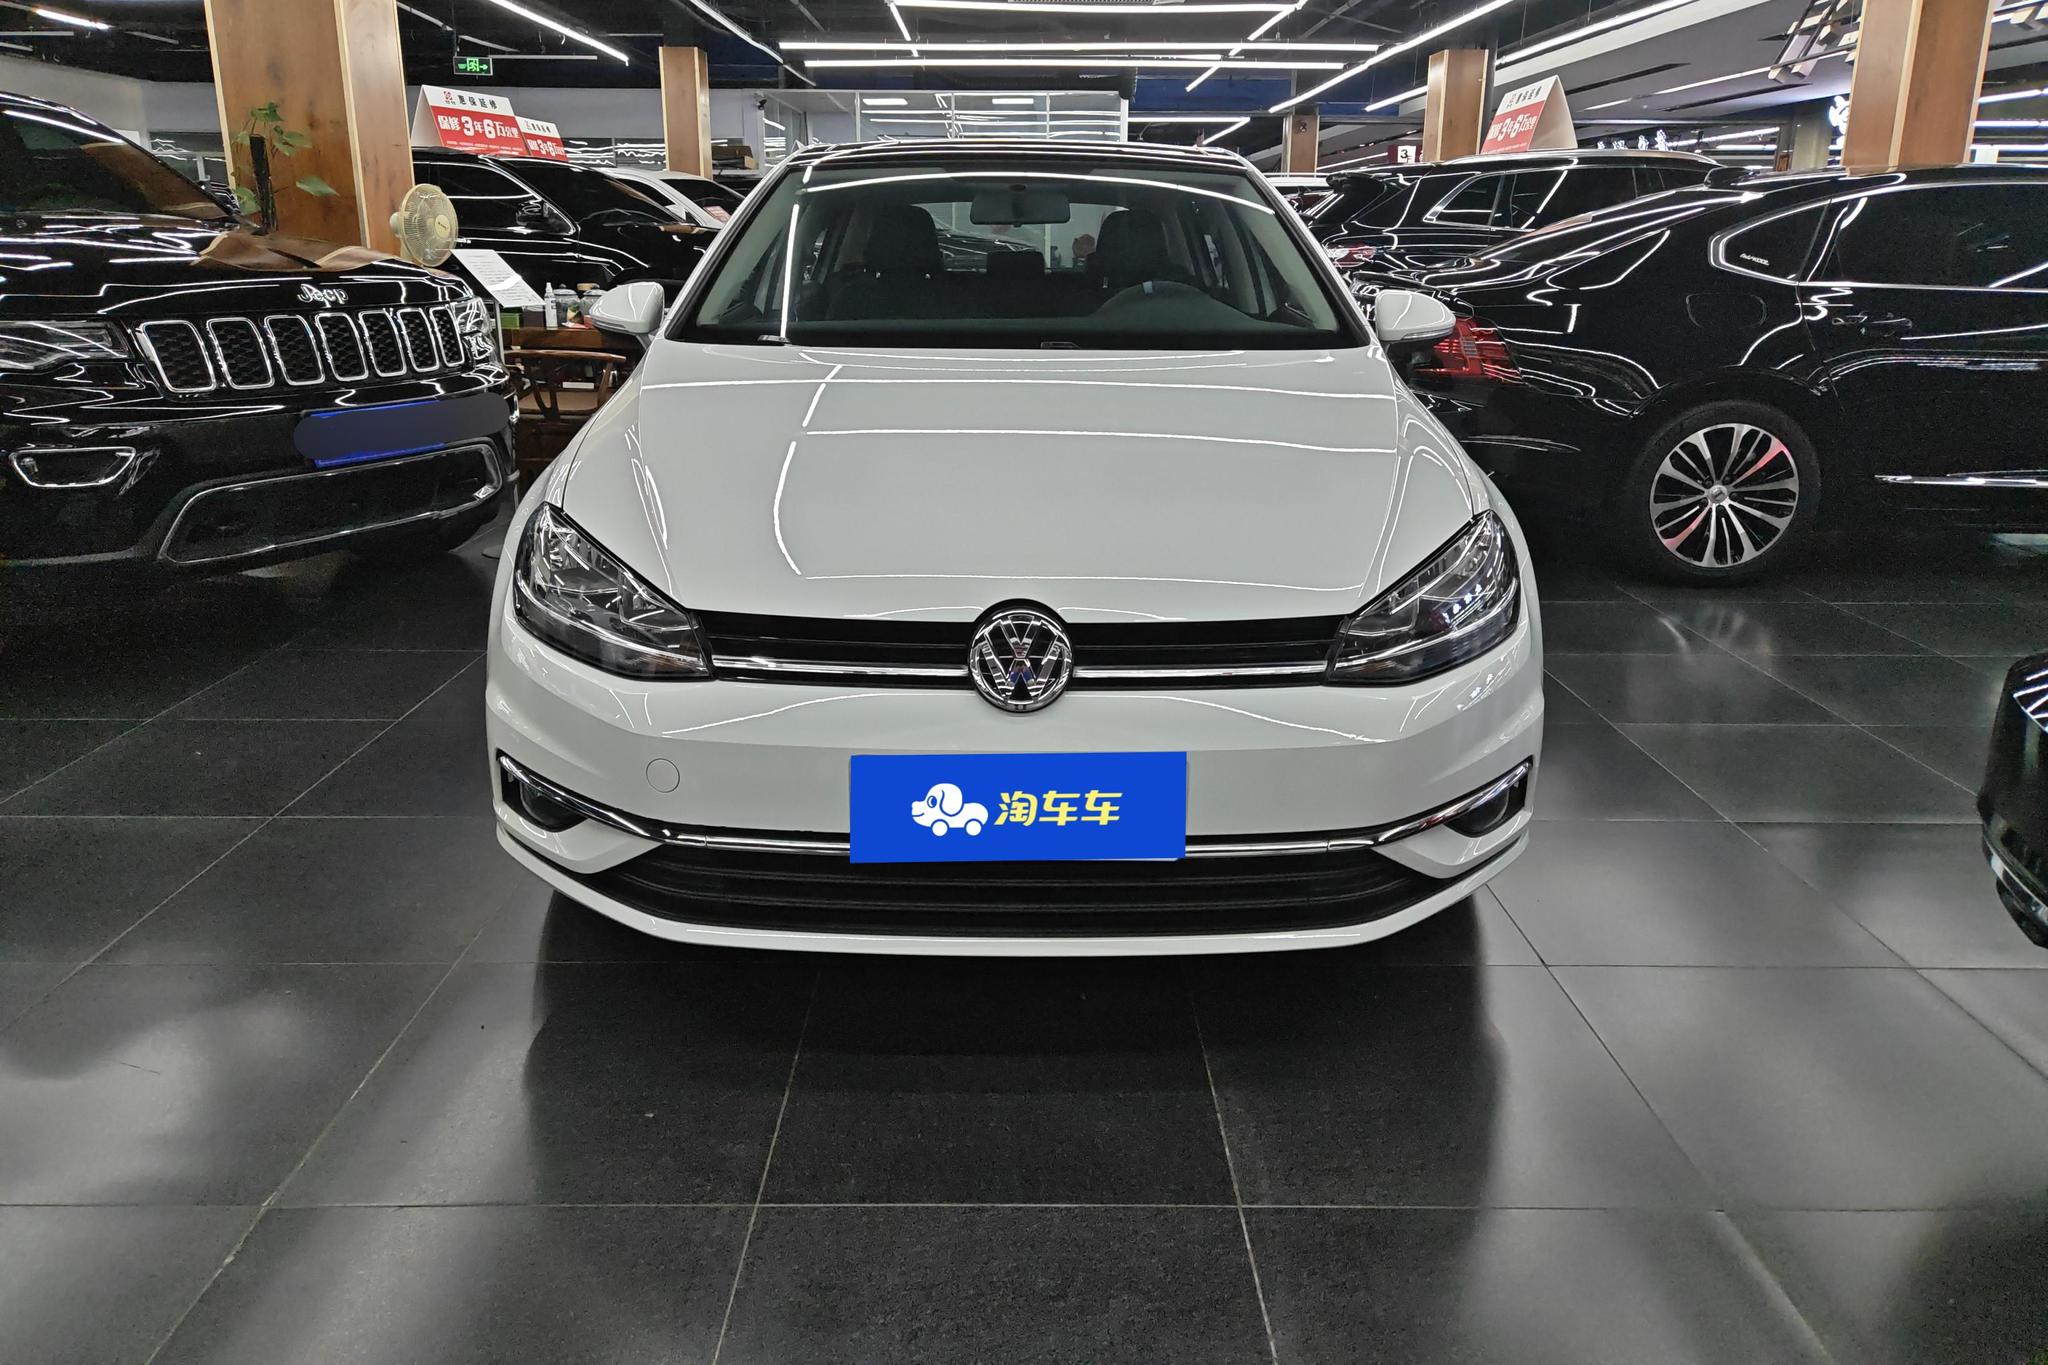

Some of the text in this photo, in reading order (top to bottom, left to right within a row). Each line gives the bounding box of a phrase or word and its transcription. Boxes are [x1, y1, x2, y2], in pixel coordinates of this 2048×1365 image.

[437, 115, 521, 139] 保修3年6万公里
[297, 284, 349, 307] Jeep
